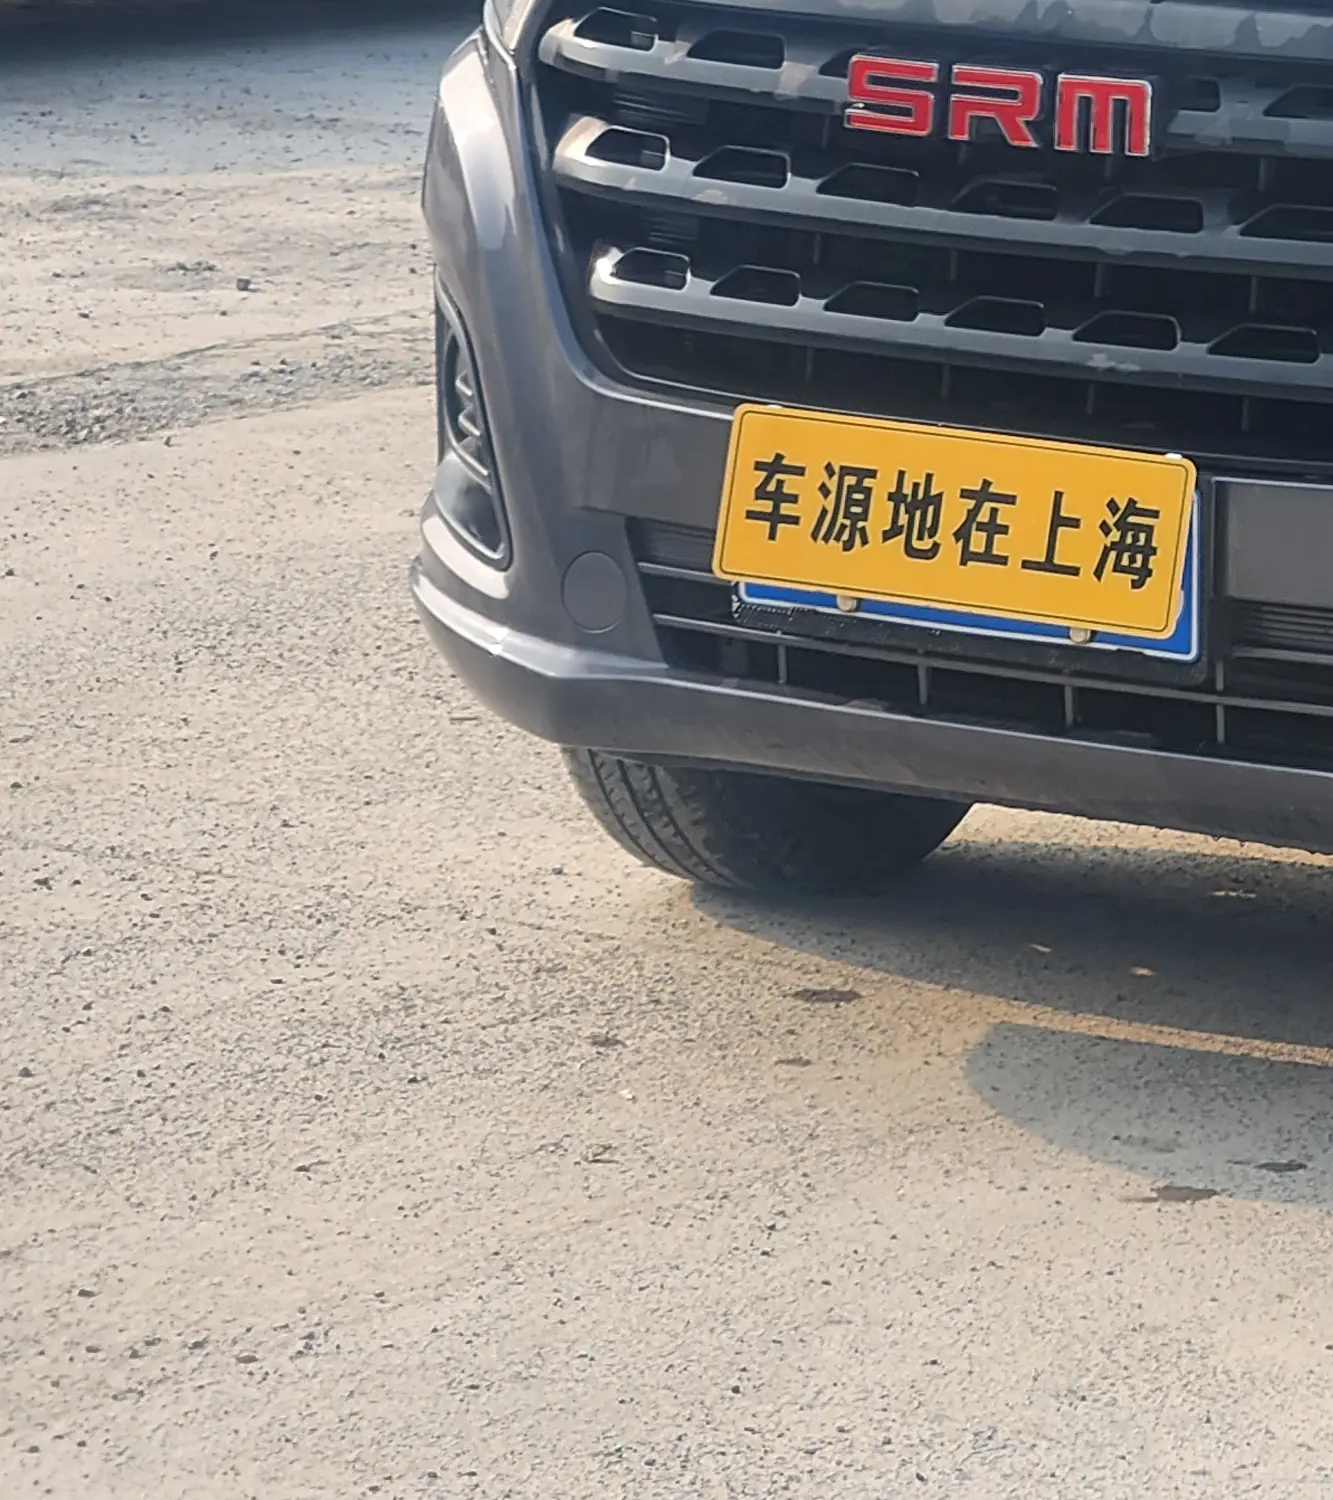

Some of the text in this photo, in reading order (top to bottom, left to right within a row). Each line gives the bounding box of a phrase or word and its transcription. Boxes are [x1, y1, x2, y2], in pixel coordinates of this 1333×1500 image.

[845, 54, 1153, 156] SRM
[745, 452, 1160, 590] 车源地在上海
